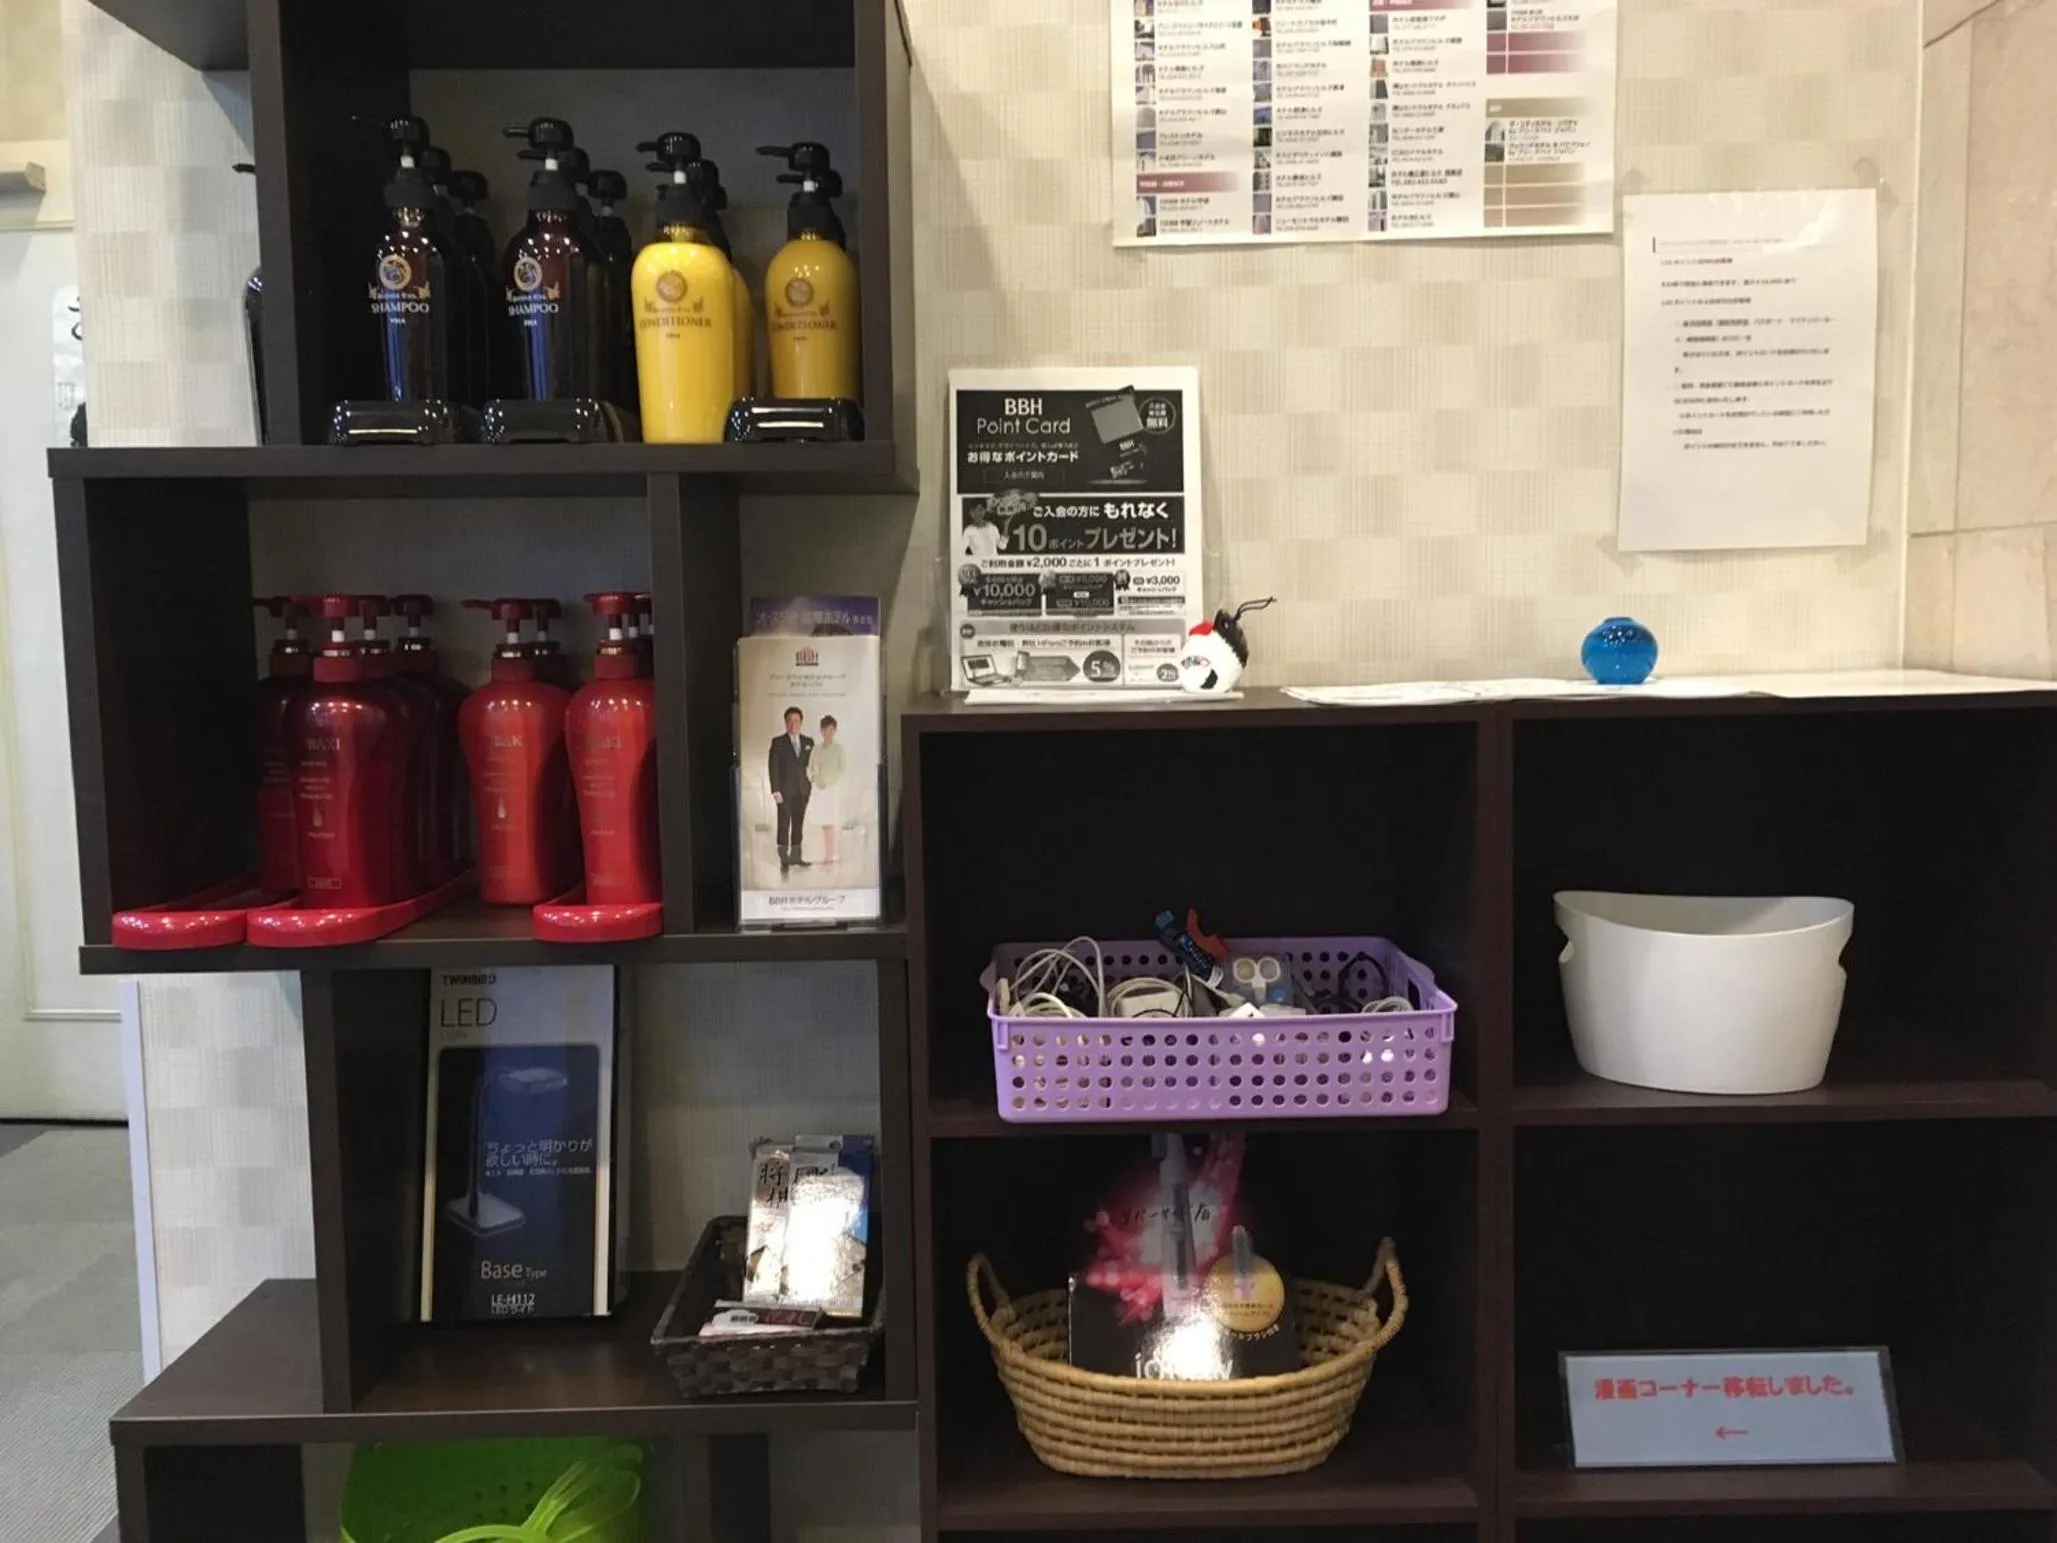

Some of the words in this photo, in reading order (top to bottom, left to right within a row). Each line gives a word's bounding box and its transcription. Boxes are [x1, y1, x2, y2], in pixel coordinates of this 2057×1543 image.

[371, 302, 430, 314] SHAMPOO
[1004, 397, 1043, 415] BBH
[977, 418, 1020, 434] Point
[1026, 417, 1071, 434] Card
[1033, 506, 1100, 518] ご入会の方に
[1103, 502, 1169, 519] もれなく
[1013, 524, 1047, 551] 10
[441, 998, 497, 1027] LED
[486, 1138, 592, 1153] ちょっと明かりが
[481, 1260, 524, 1279] Base
[1595, 1375, 1854, 1400] 漫画コーナー移転しました。
